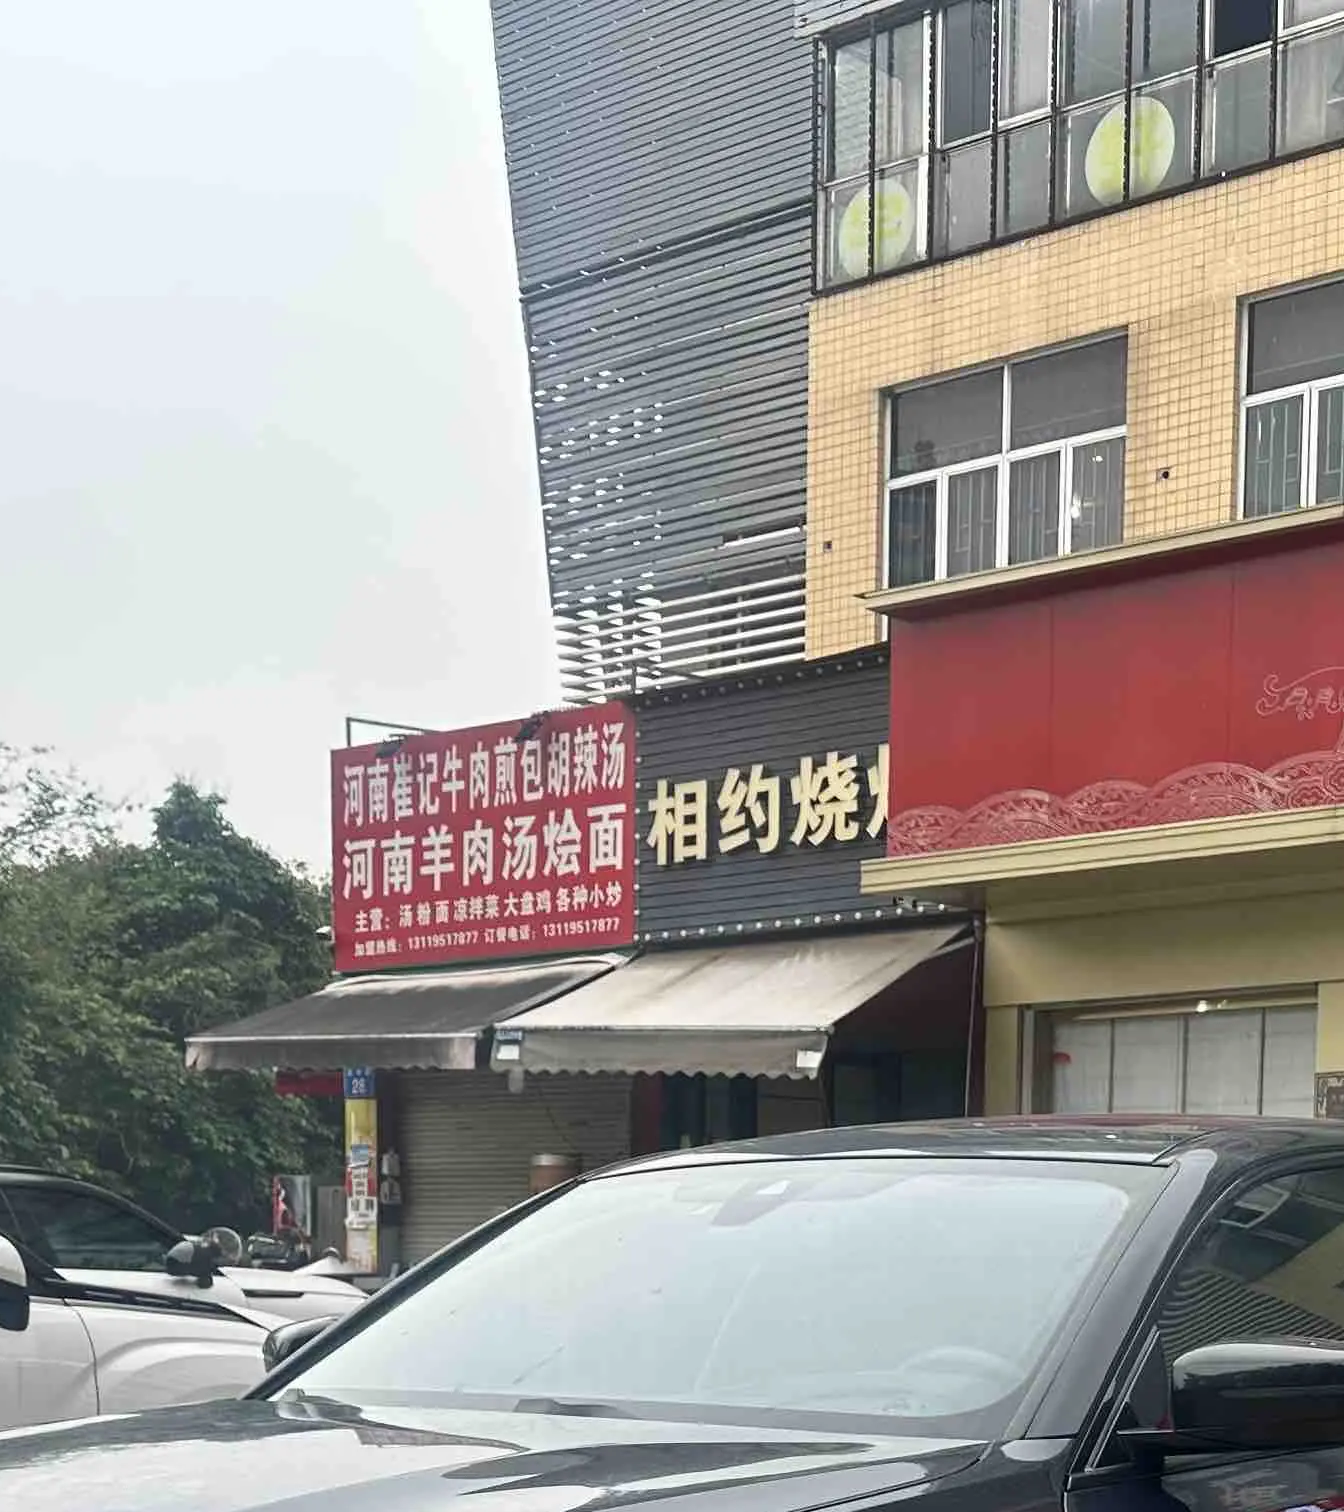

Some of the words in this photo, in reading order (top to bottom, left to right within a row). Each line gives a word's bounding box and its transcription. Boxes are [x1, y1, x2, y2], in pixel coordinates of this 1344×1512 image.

[343, 722, 626, 827] 河南崔记牛肉煎包胡辣汤
[342, 803, 627, 899] 河南羊肉汤烩面
[542, 917, 620, 939] 13119517877
